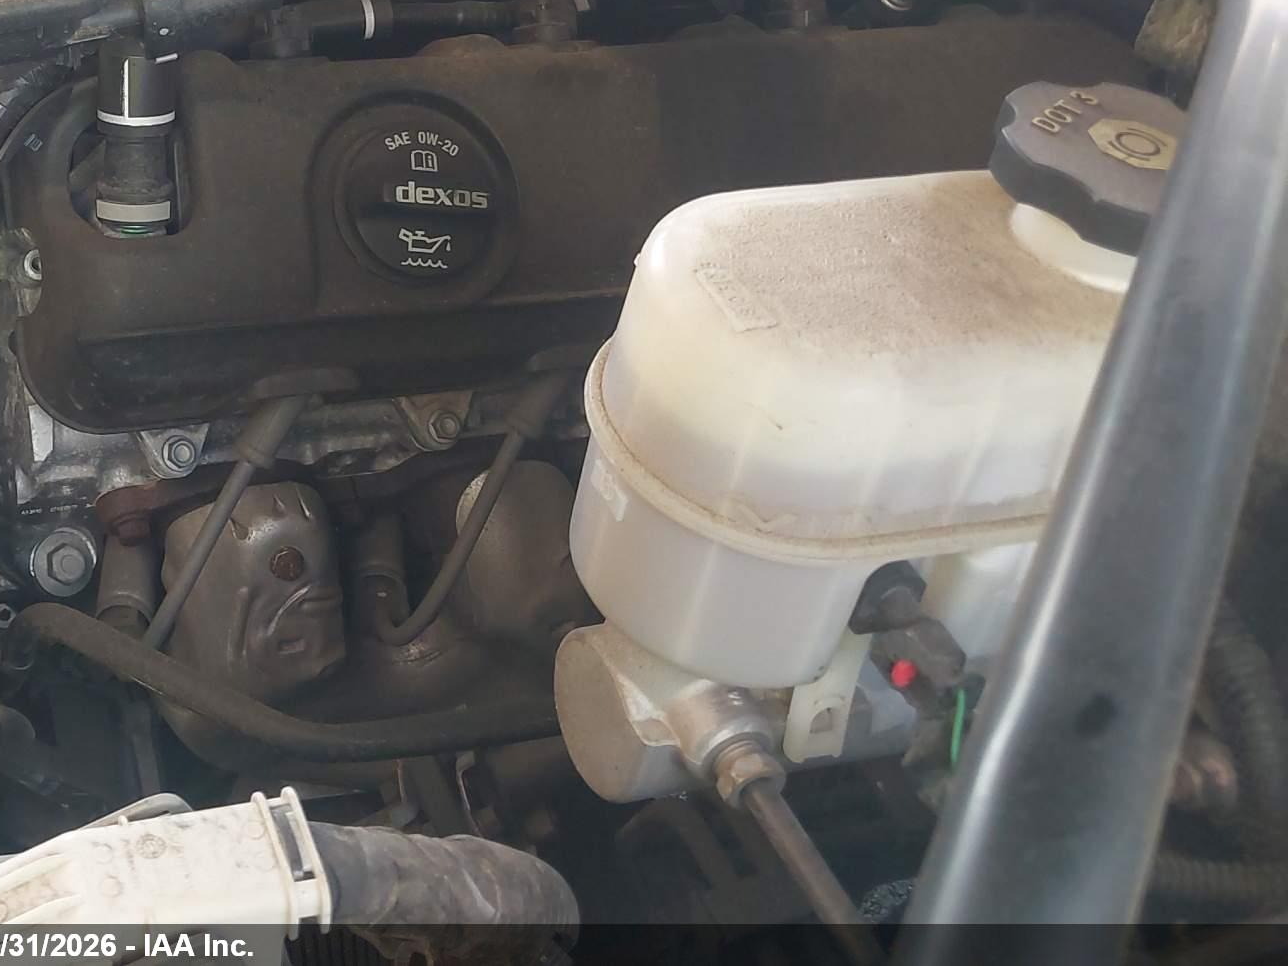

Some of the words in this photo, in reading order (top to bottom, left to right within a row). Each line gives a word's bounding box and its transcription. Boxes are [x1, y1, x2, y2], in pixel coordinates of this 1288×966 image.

[1032, 99, 1082, 134] DOT
[1070, 90, 1099, 106] 3
[384, 131, 411, 151] SAE
[418, 131, 459, 157] 0W-20
[395, 181, 488, 209] dexos
